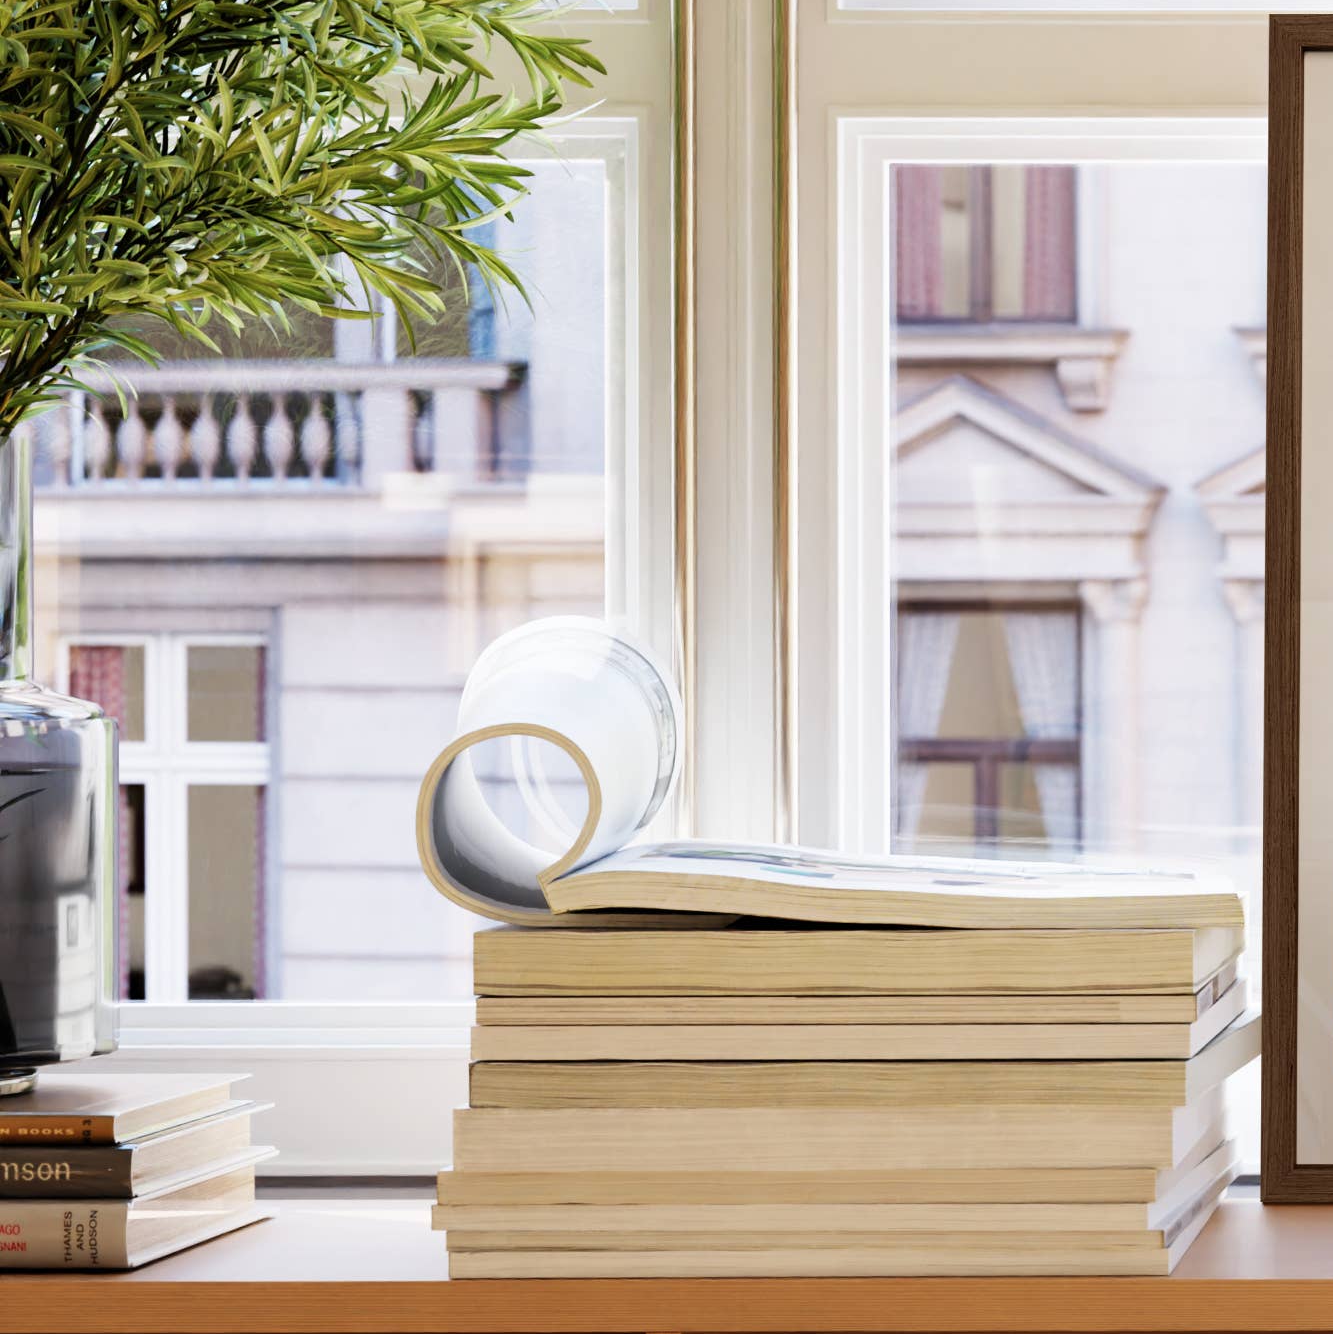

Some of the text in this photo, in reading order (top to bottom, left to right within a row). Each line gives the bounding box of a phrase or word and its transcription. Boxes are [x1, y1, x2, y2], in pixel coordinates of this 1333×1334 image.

[63, 1211, 73, 1263] THAMES
[76, 1223, 85, 1251] AND
[88, 1210, 99, 1265] HUDSON
